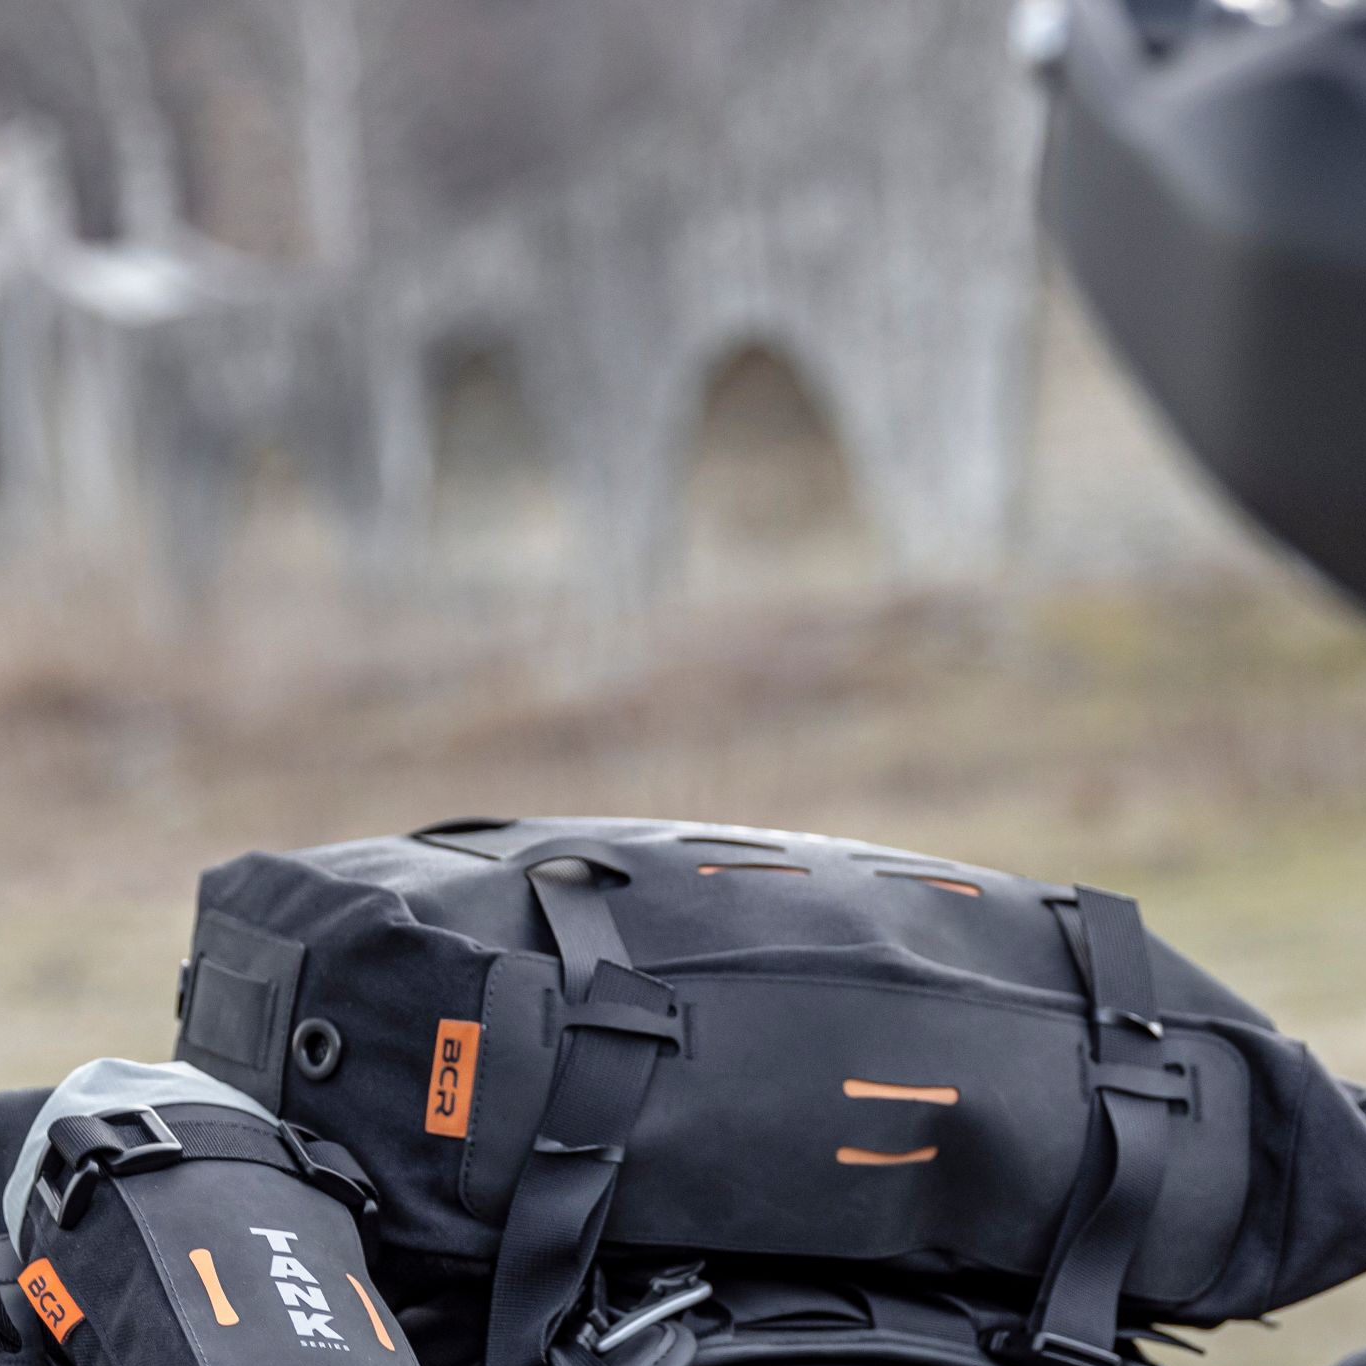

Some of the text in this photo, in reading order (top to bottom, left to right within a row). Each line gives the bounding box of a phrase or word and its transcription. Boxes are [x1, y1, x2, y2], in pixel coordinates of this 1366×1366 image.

[435, 1037, 462, 1117] BCR
[28, 1275, 66, 1329] BCR
[249, 1226, 346, 1341] TANK
